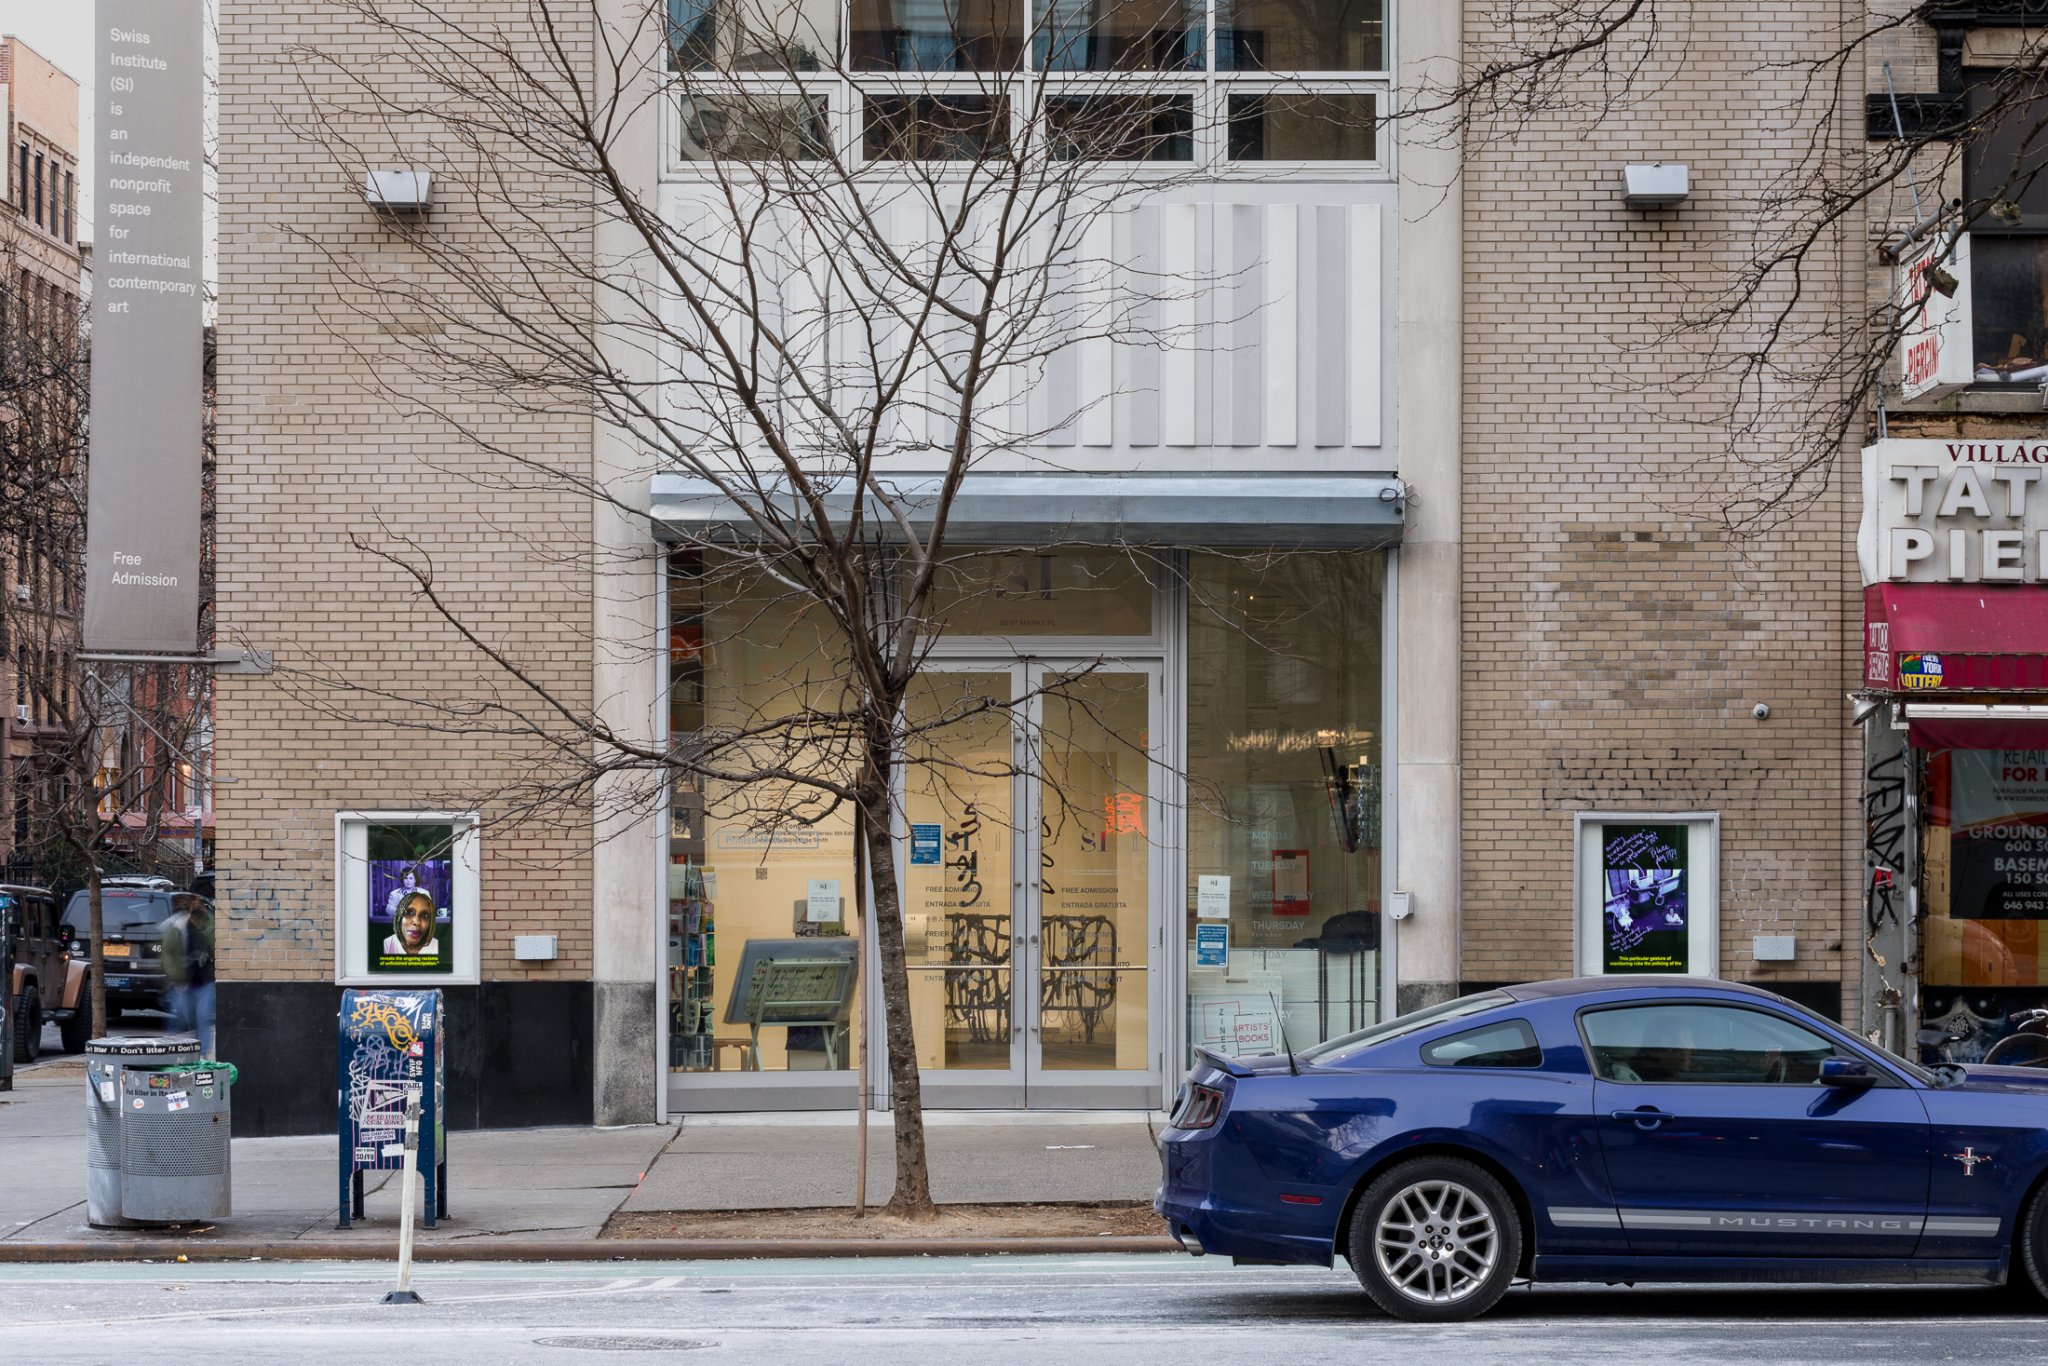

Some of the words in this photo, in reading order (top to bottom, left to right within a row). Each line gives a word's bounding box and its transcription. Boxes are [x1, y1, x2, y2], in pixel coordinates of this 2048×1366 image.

[110, 28, 151, 44] Swiss
[110, 52, 168, 71] Institute
[110, 77, 134, 93] (SI)
[110, 100, 123, 115] is
[110, 128, 128, 141] an
[110, 151, 190, 171] independent
[110, 177, 171, 194] nonprofit
[110, 202, 151, 217] space
[109, 225, 130, 239] for
[109, 249, 191, 269] international
[108, 275, 196, 297] contemporary
[108, 301, 129, 313] art
[1946, 444, 2048, 463] VILLAG
[1889, 465, 2042, 517] TAT
[113, 551, 142, 565] Free
[112, 571, 177, 587] Admission
[1923, 661, 1942, 674] YORK
[1901, 673, 1944, 688] LOTTERY
[2003, 750, 2047, 765] RETAIL
[2002, 767, 2038, 782] FOR
[1252, 831, 1295, 840] MONDAY
[1969, 825, 2047, 839] GROUND
[1080, 831, 1108, 852] SI
[2005, 840, 2032, 852] 600
[1251, 861, 1296, 870] TUESDAY
[2006, 872, 2031, 884] 150
[2003, 901, 2023, 910] 646
[2024, 901, 2044, 910] 943
[1252, 921, 1304, 930] THURSDAY
[1238, 1034, 1269, 1043] BOOKS
[1719, 1216, 1901, 1229] MUSTANG
